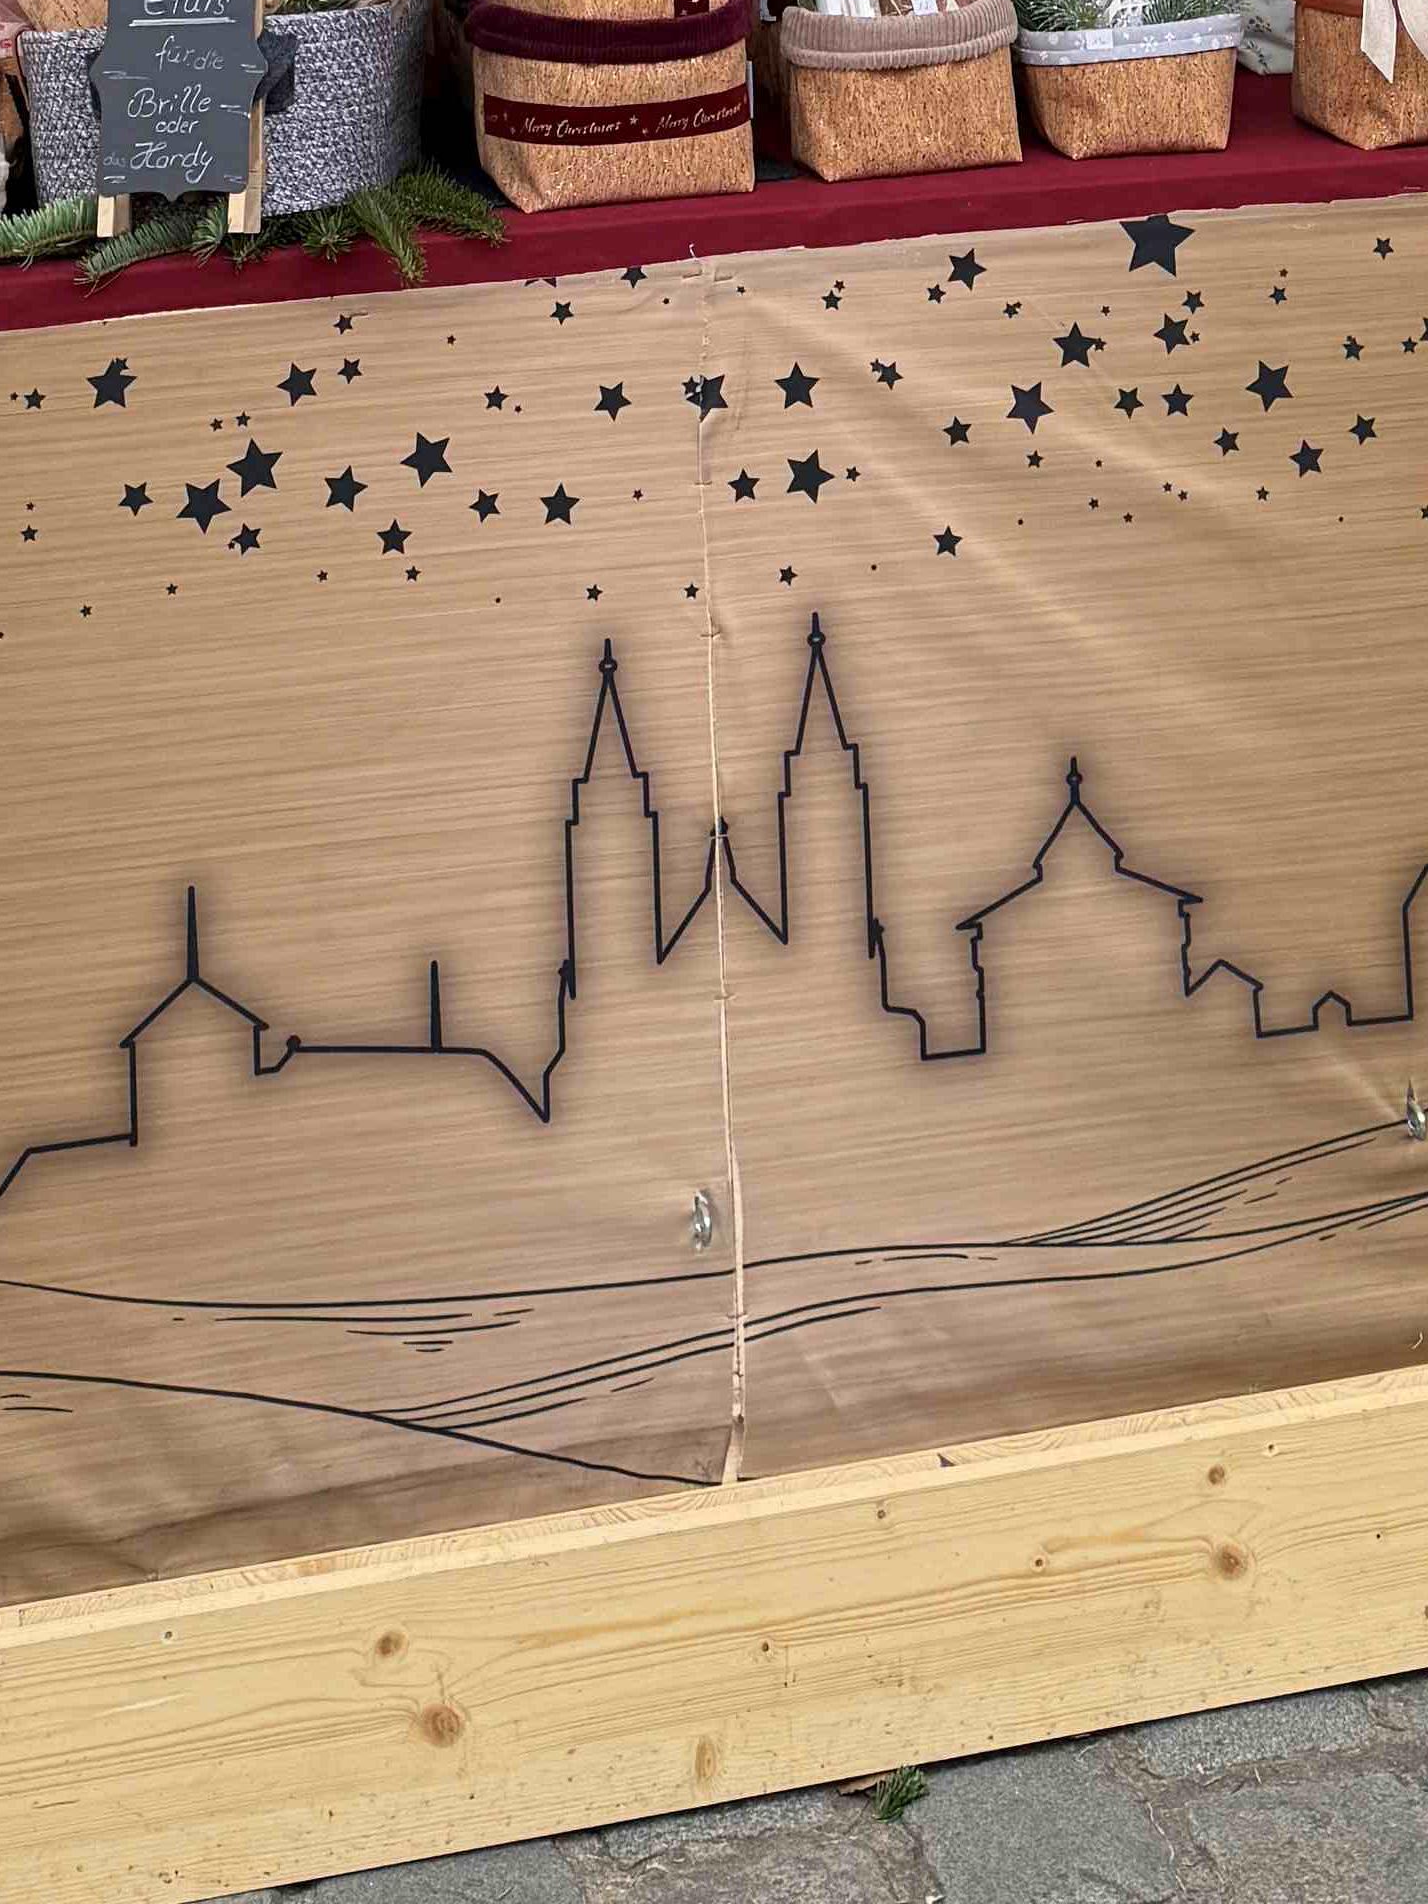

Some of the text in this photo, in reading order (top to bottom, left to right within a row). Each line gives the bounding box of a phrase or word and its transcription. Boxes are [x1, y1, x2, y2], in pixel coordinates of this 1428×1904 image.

[155, 35, 225, 71] für die
[127, 84, 212, 118] Brille
[155, 116, 200, 134] oder
[521, 116, 551, 137] Merry
[555, 118, 622, 139] Christmas
[656, 112, 689, 133] Merry
[129, 141, 216, 184] Handy
